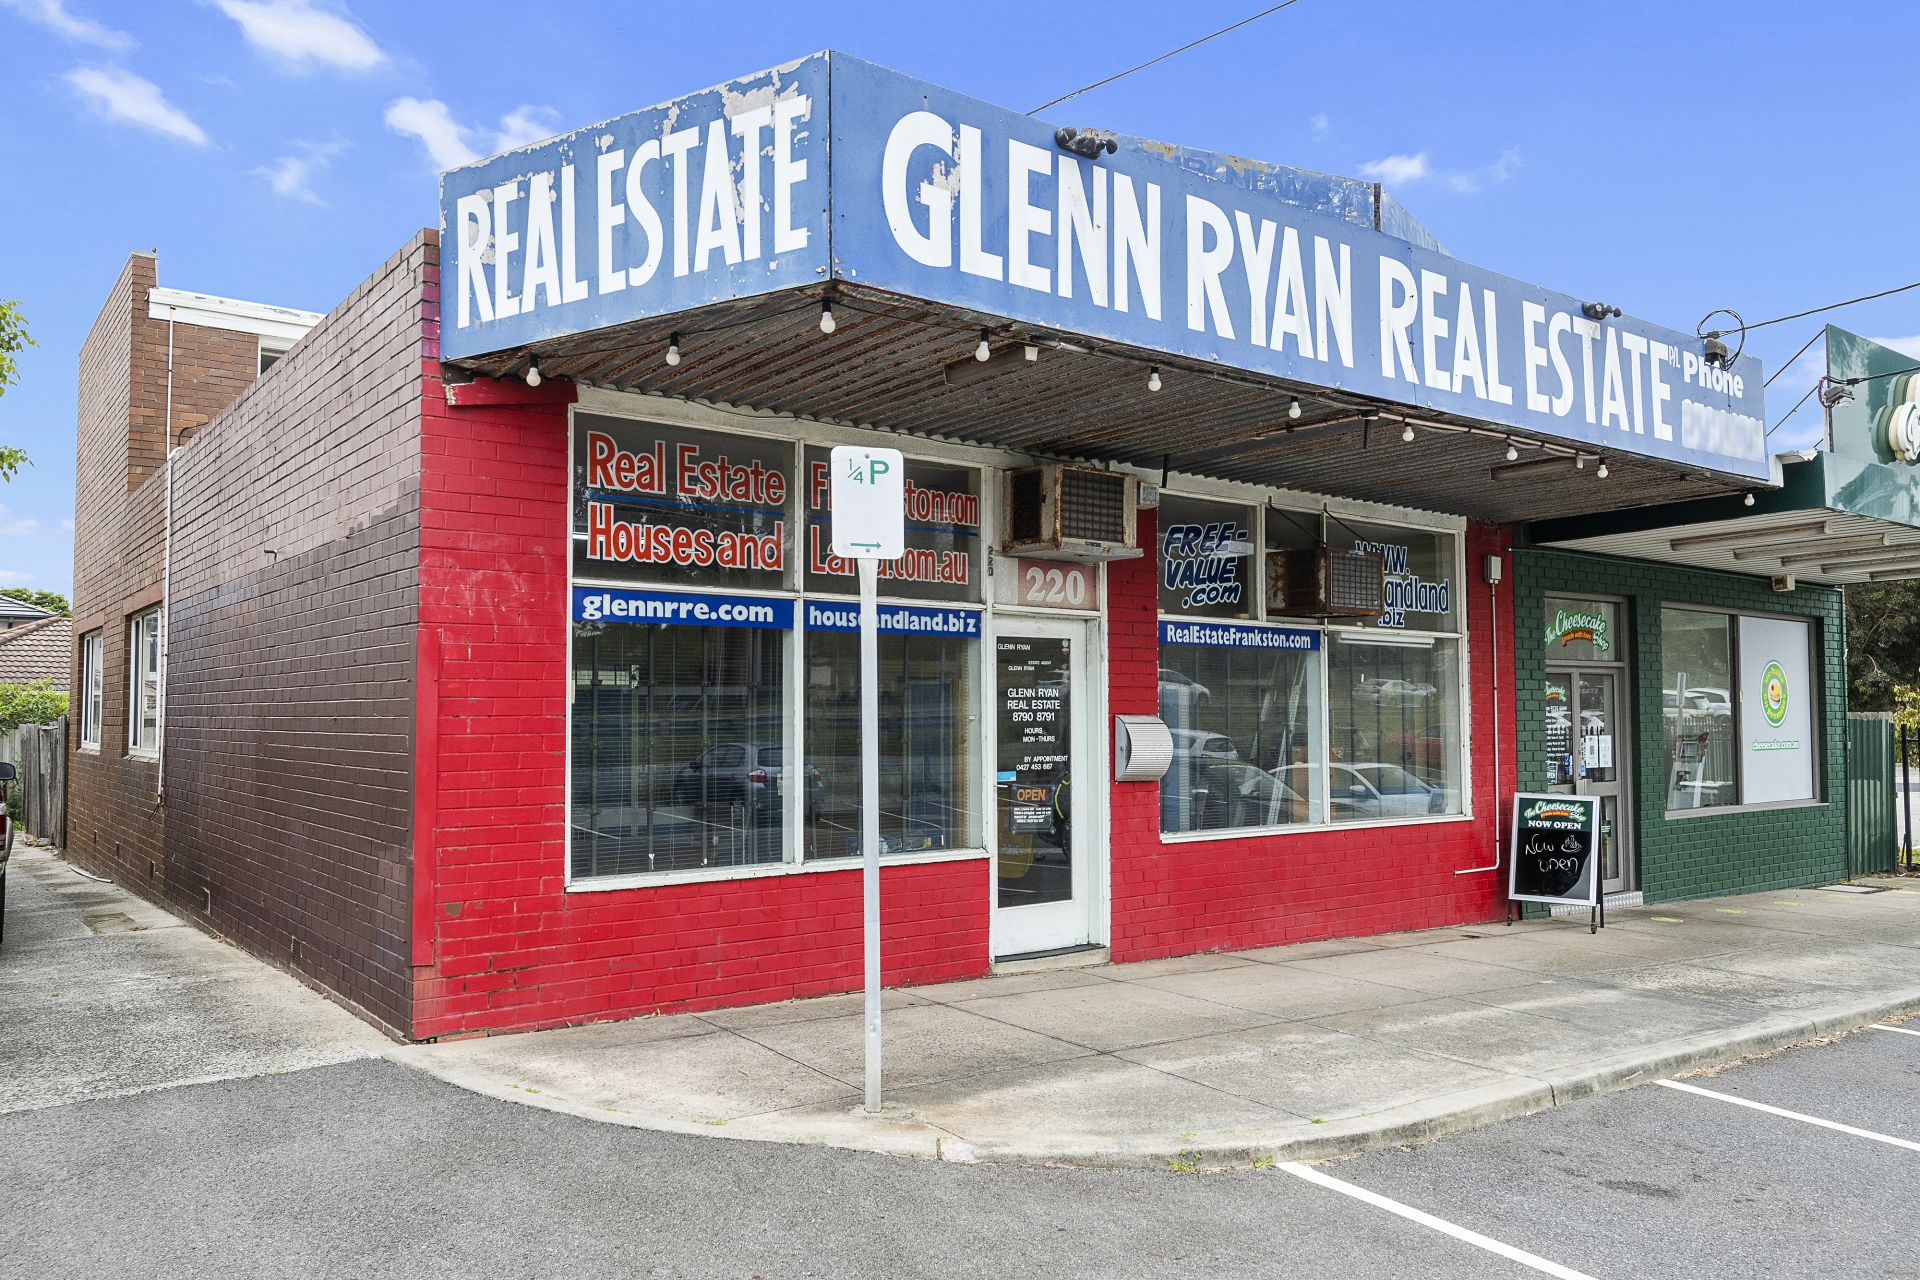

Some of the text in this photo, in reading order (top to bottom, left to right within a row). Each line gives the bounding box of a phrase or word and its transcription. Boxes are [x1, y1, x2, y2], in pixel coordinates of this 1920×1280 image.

[457, 95, 810, 329] REAL ESTATE
[882, 111, 1161, 321] GLENN
[1185, 194, 1354, 368] RYAN
[1379, 255, 1512, 405] REAL
[1522, 300, 1673, 442] ESTATE
[1683, 351, 1744, 398] Phone
[587, 431, 665, 494] Real
[677, 442, 786, 505] Estate
[1162, 521, 1249, 558] FREE-
[1026, 567, 1085, 605] 220
[1164, 556, 1237, 590] VALUE
[582, 592, 774, 623] glennrre.com
[1181, 582, 1242, 609] .com
[1166, 625, 1311, 649] RealEstateFrankston.com
[1555, 609, 1607, 636] Cheesecake
[1007, 700, 1061, 710] REAL ESTATE
[1008, 688, 1060, 698] GLENN RYAN
[1012, 712, 1055, 721] 8790 8791
[1017, 789, 1046, 801] OPEN
[1527, 820, 1582, 830] NOW OPEN
